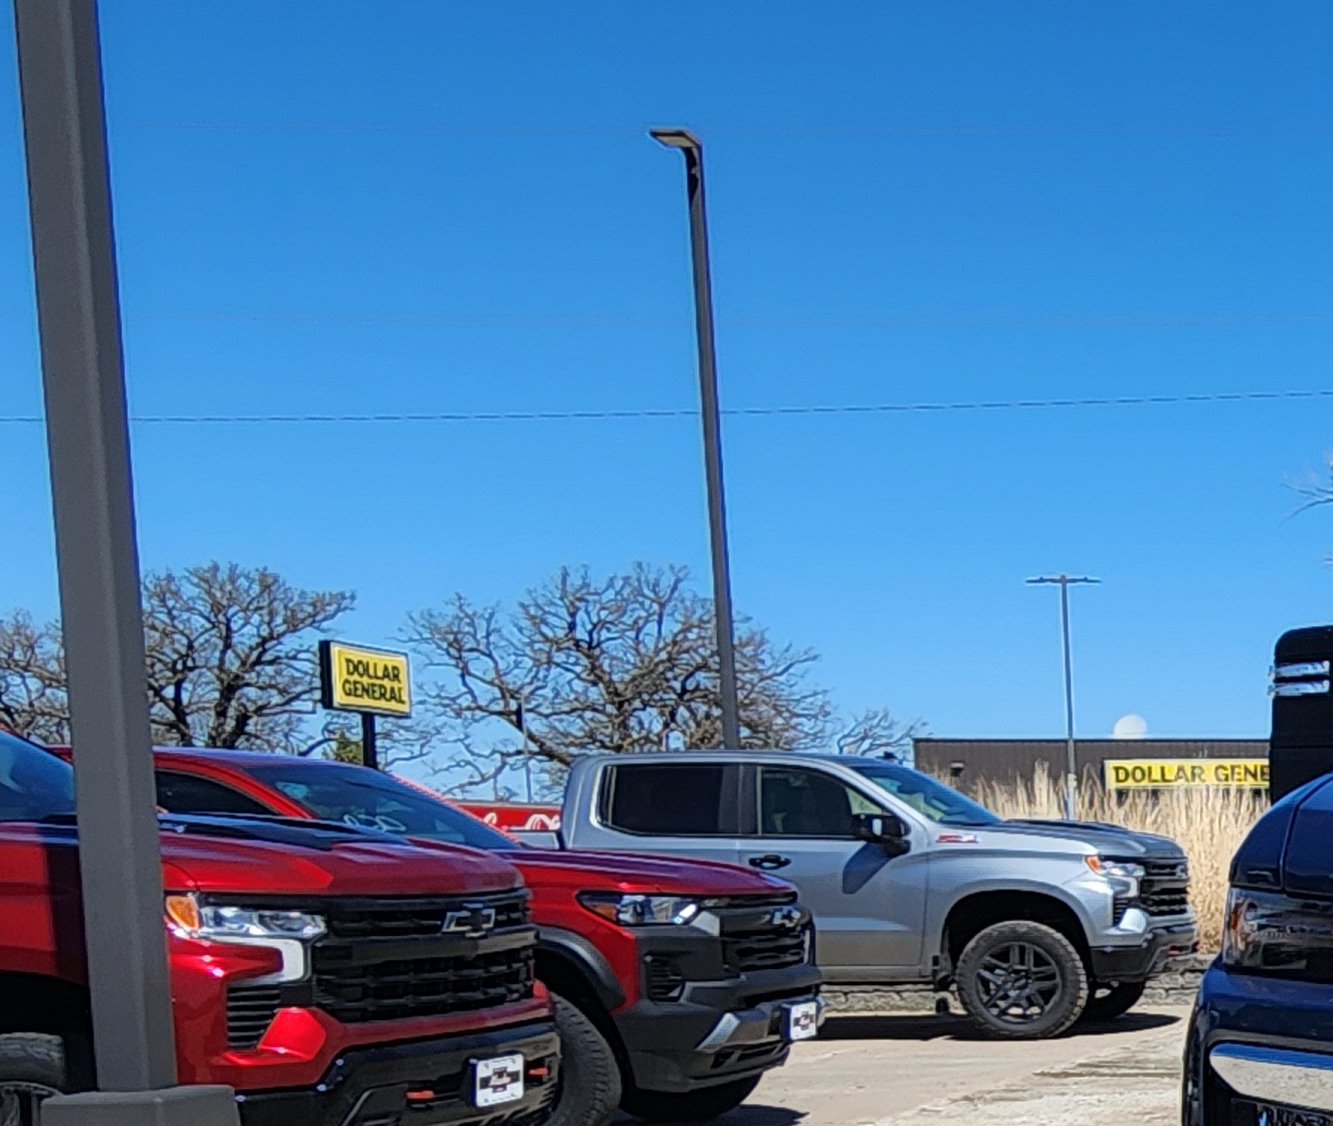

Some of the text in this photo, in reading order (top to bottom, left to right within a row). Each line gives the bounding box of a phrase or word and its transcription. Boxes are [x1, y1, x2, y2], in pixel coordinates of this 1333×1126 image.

[344, 657, 401, 683] DOLLAR
[342, 678, 406, 705] GENERAL
[1112, 764, 1206, 784] DOLLAR
